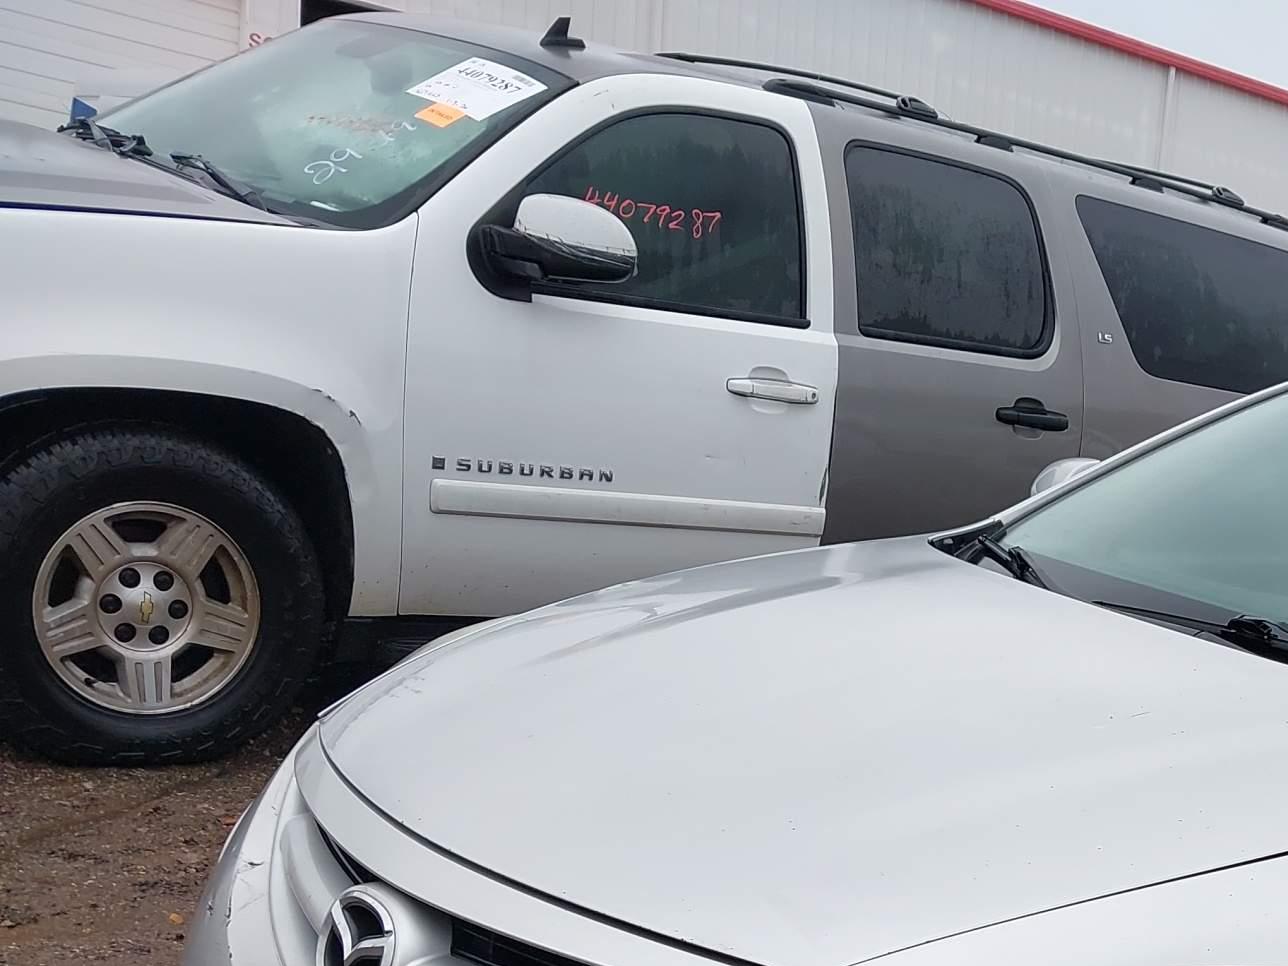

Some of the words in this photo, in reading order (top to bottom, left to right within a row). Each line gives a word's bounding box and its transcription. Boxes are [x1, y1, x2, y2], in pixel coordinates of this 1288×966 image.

[458, 67, 522, 94] 44079287
[584, 186, 721, 239] 44079287
[1098, 331, 1113, 343] LS
[456, 458, 614, 482] SUBURBAN
